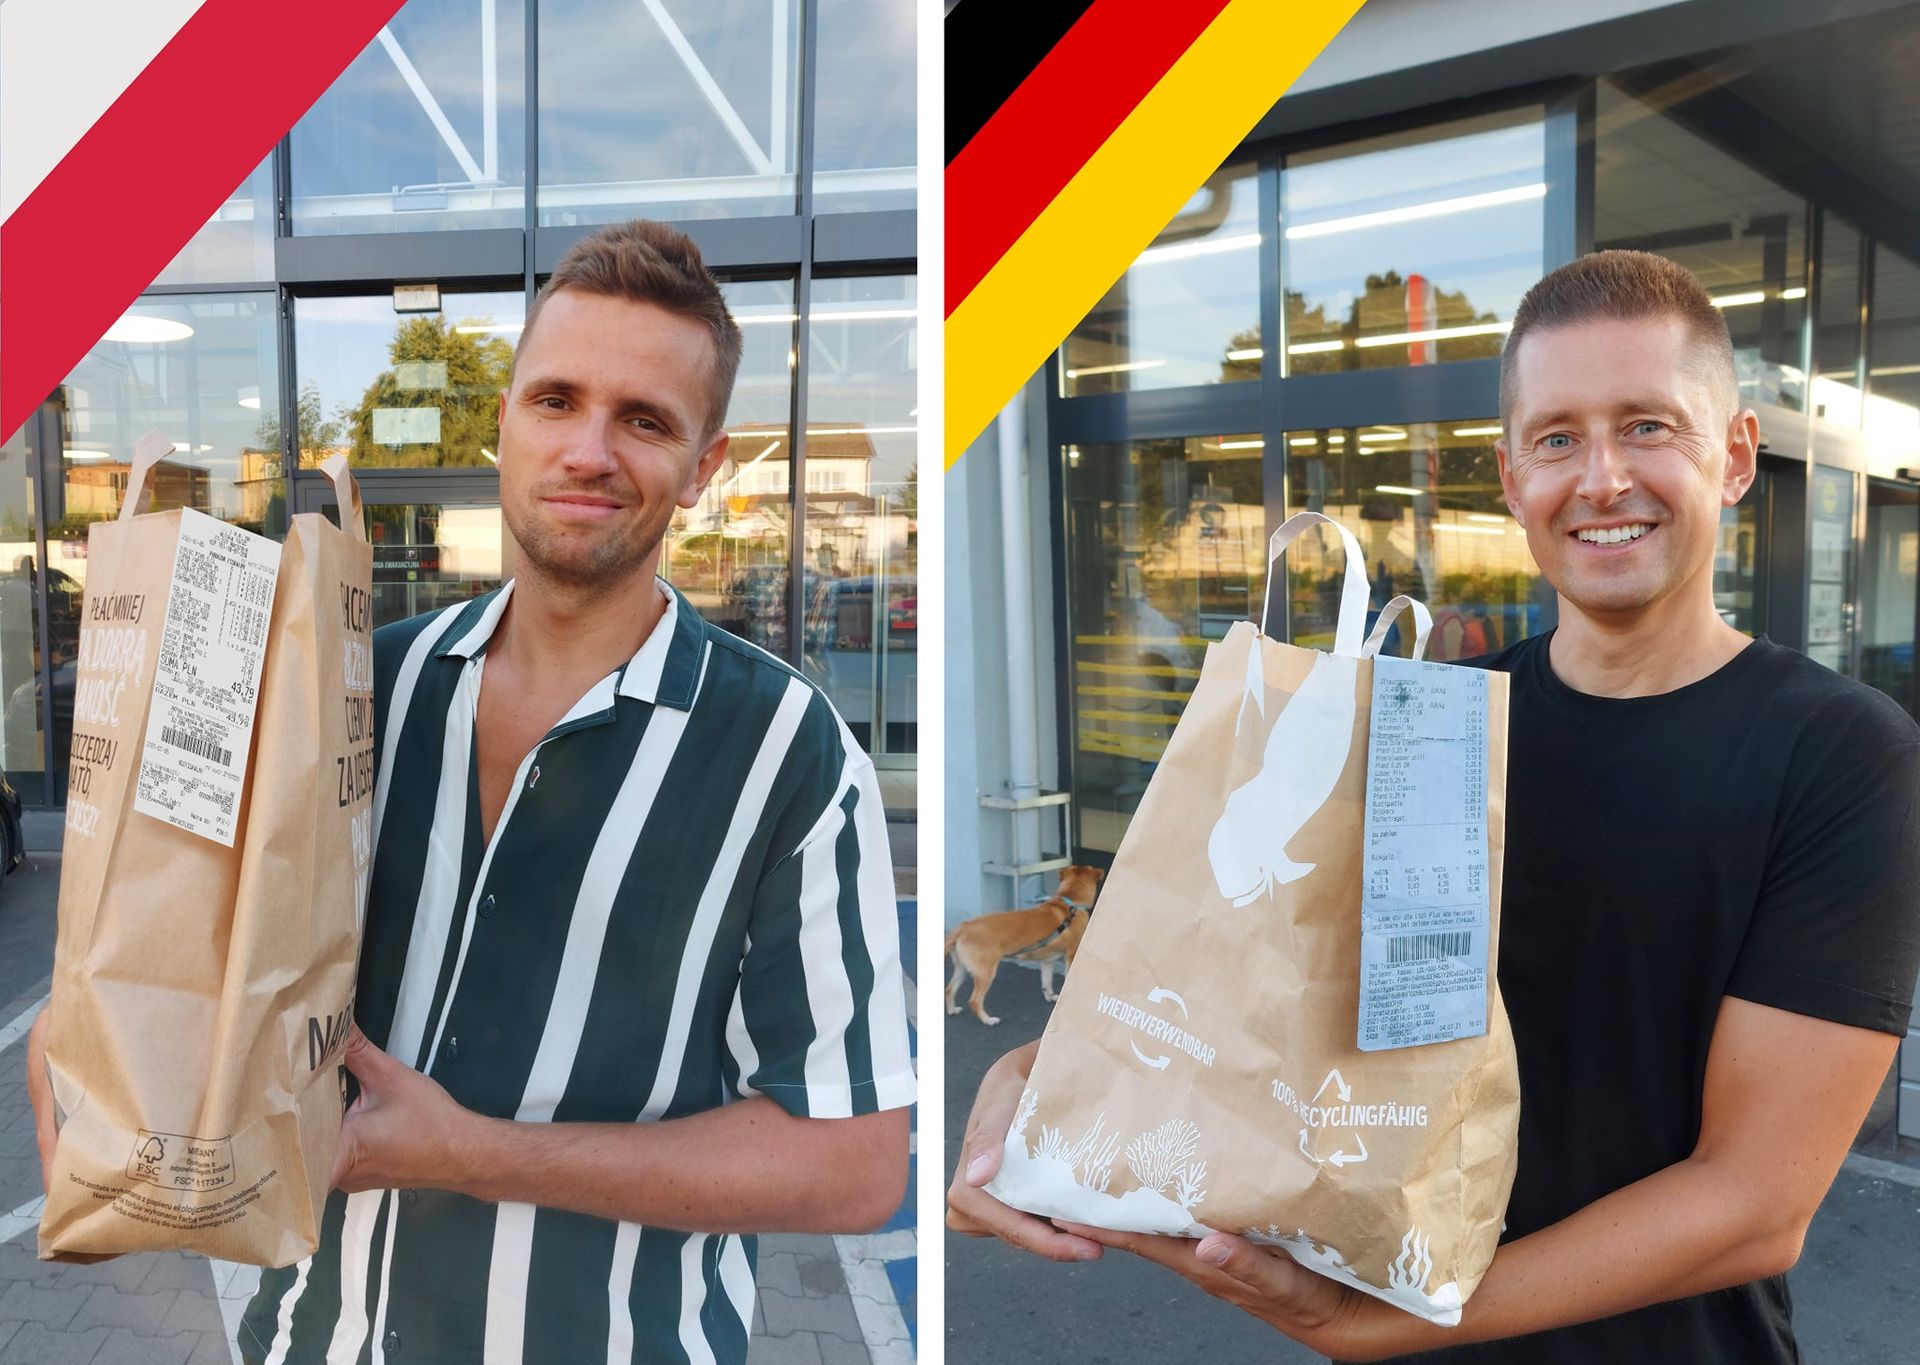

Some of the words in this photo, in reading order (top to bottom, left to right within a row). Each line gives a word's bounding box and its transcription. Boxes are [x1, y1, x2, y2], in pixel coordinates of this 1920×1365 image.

[182, 661, 197, 677] PLN
[230, 680, 254, 699] 43,79
[1097, 992, 1217, 1067] WIEDERVERWENDBAR
[1272, 1078, 1299, 1114] 100%
[1299, 1101, 1429, 1128] RECYCLINGFÄHIG
[136, 1163, 161, 1176] FSC
